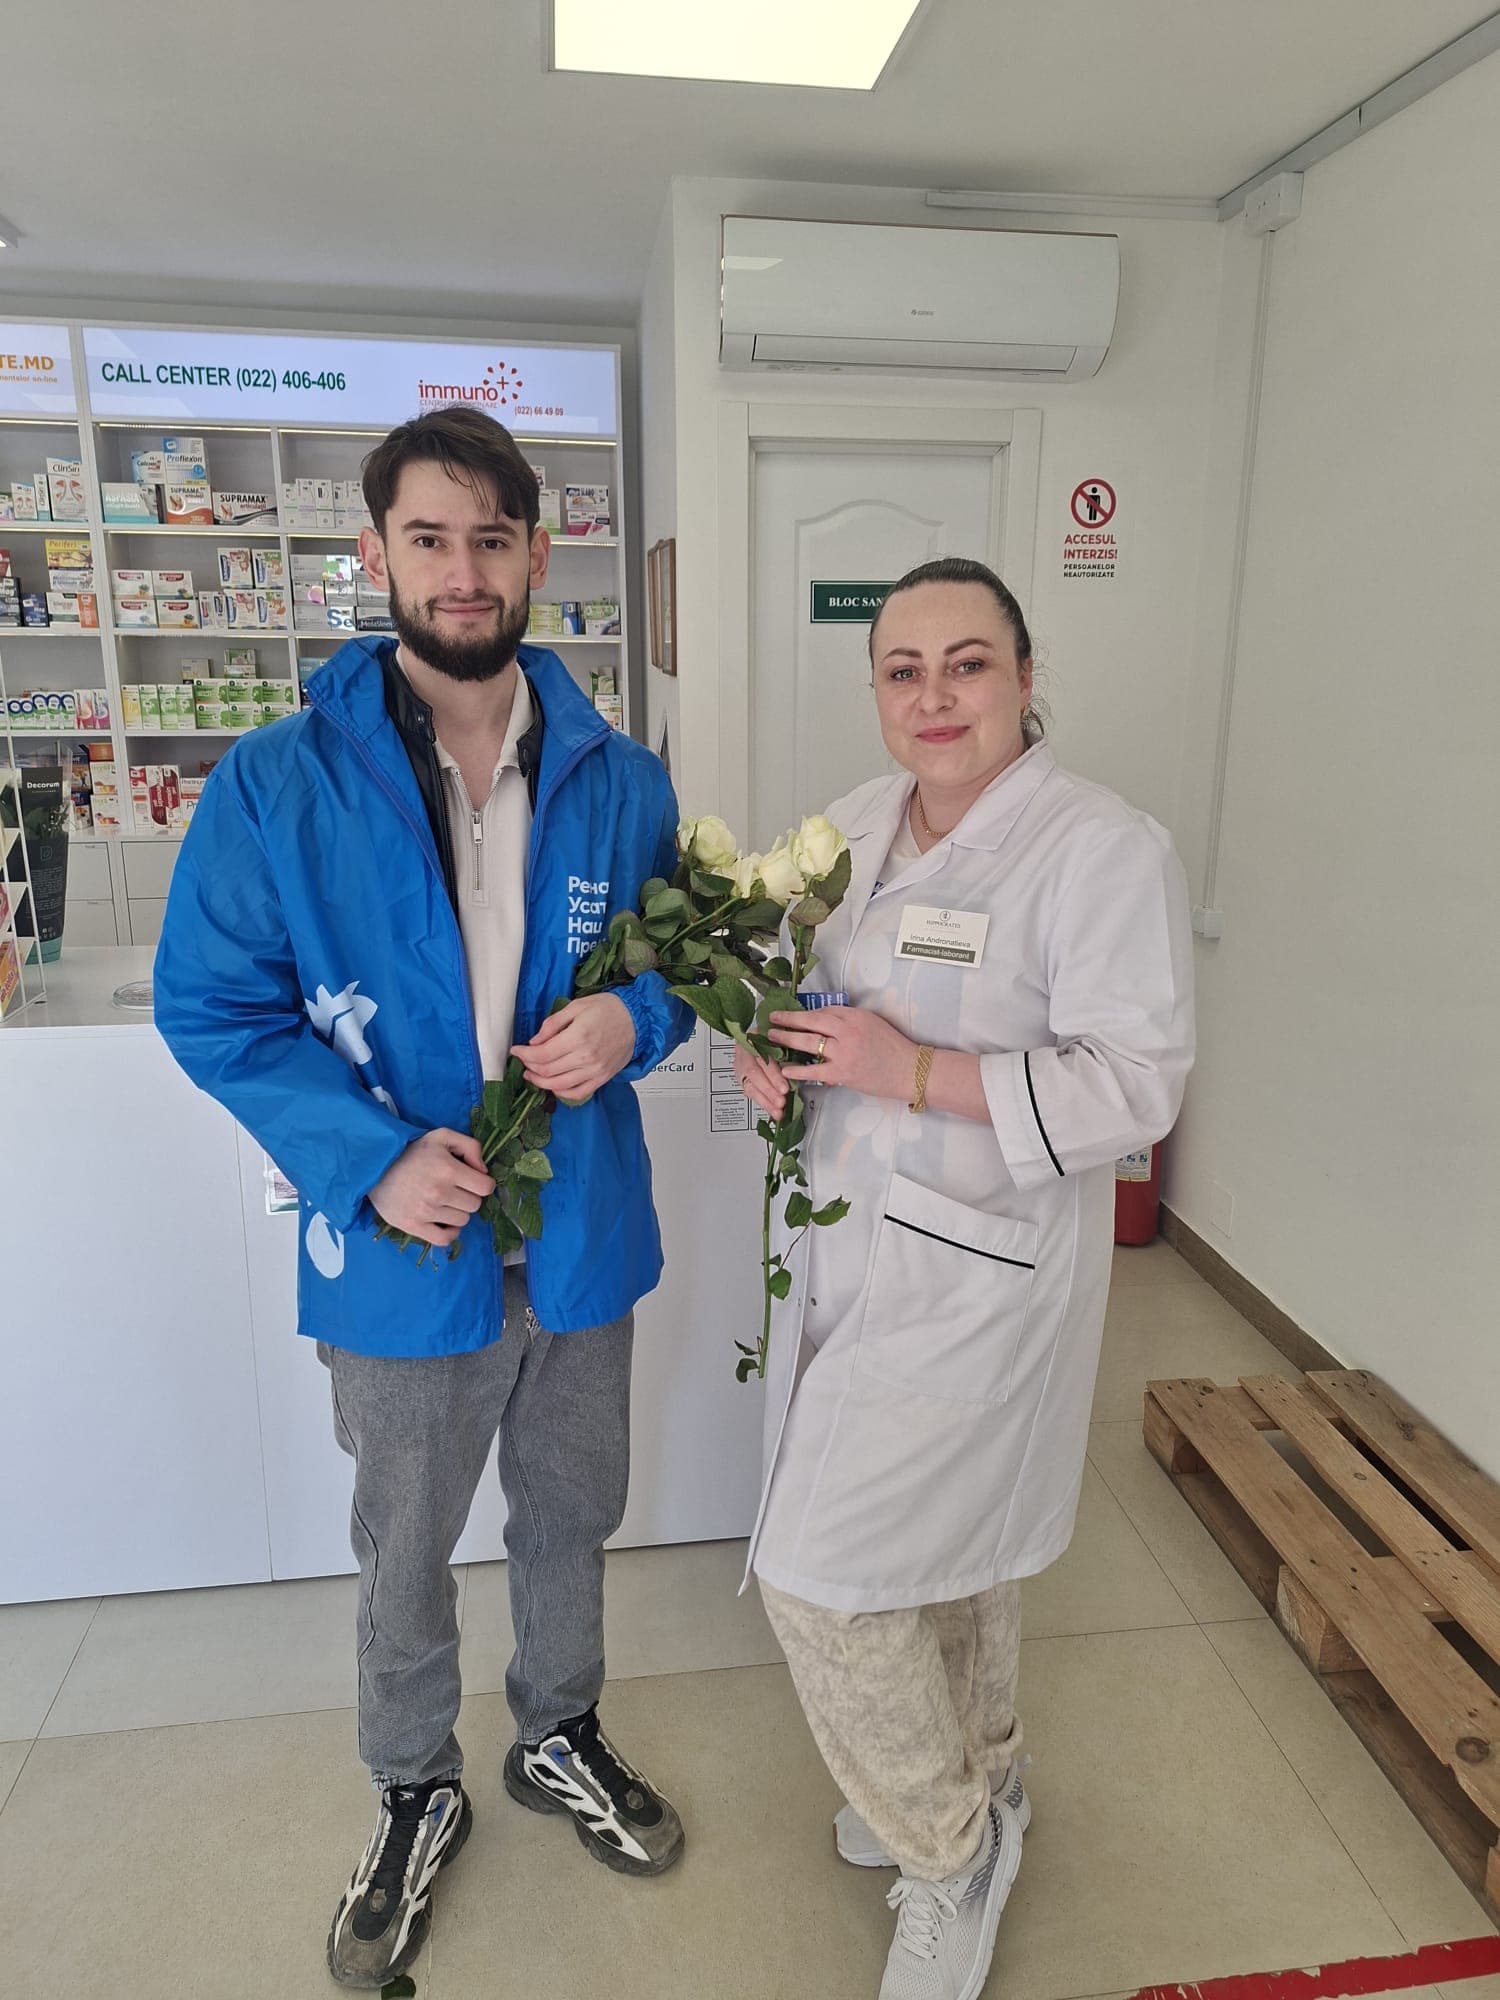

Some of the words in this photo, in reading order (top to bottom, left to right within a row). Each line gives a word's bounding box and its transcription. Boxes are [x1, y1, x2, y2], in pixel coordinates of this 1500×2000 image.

[102, 362, 151, 384] CALL
[156, 365, 231, 387] CENTER
[236, 368, 277, 392] (022)
[282, 371, 346, 391] 406-406
[418, 380, 498, 401] immuno
[514, 405, 533, 417] (022)
[220, 494, 266, 504] SUPRAMAX
[1064, 534, 1116, 545] ACCESUL
[1063, 549, 1118, 559] INTERZIS!
[828, 596, 860, 607] BLOC
[26, 781, 60, 789] Decorum
